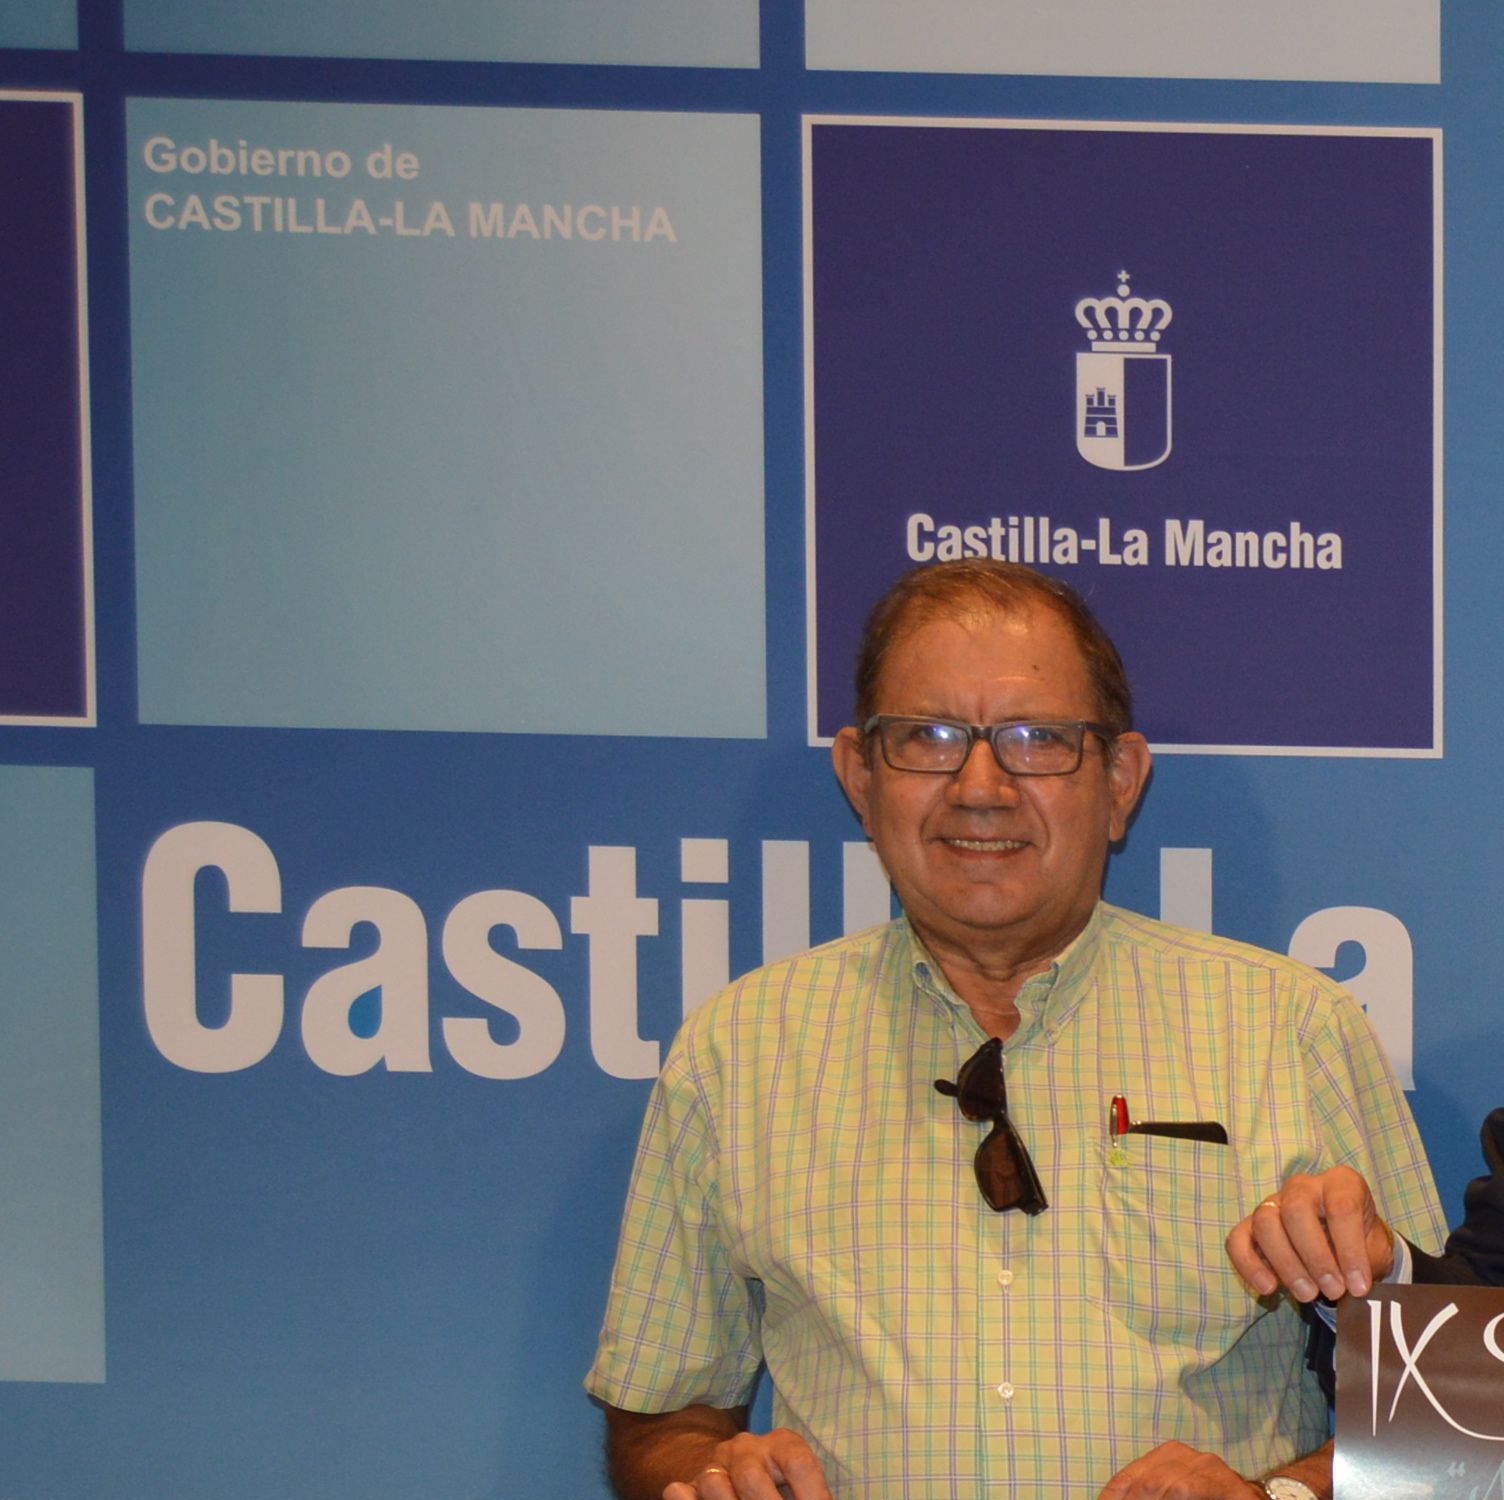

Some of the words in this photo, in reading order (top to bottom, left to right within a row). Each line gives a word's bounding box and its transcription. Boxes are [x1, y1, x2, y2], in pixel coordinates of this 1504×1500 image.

[143, 136, 351, 178] Gobierno
[367, 144, 420, 180] de
[144, 194, 456, 237] CASTILLA-LA
[469, 202, 678, 243] MANCHA
[906, 513, 1149, 566] Castilla-La
[1165, 519, 1342, 569] Mancha
